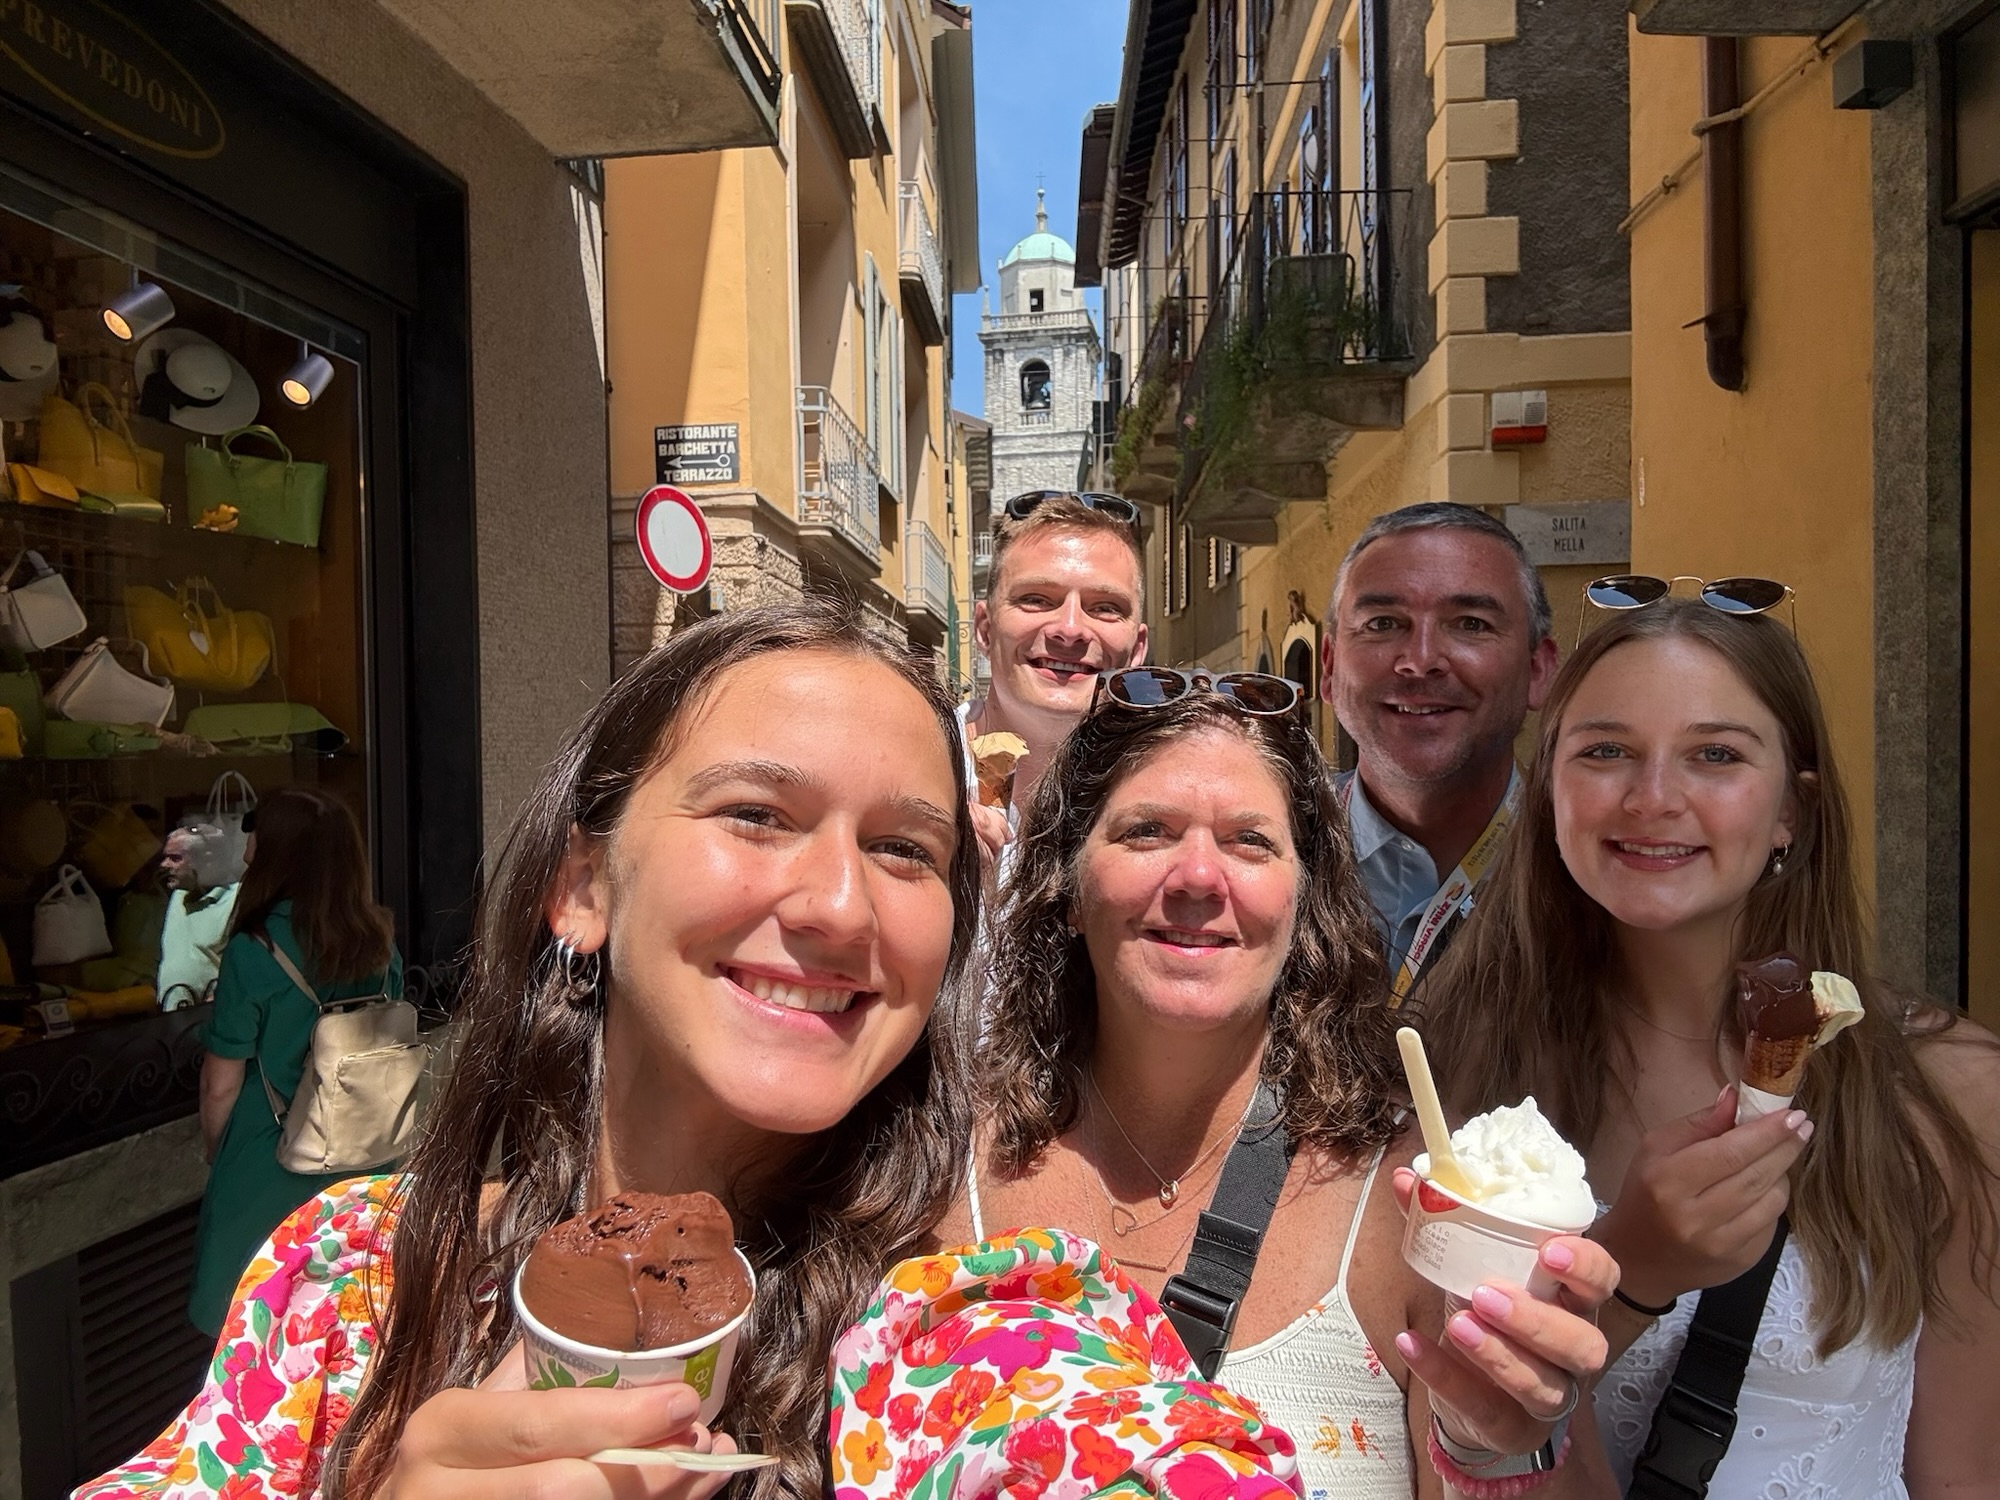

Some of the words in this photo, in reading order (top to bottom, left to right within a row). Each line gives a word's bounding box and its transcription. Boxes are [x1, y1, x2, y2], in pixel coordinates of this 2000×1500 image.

[657, 425, 737, 440] RISTORANTE
[658, 441, 736, 456] BARCHETTA
[664, 468, 732, 482] TERRAZZO
[1552, 517, 1586, 532] SALITA
[1554, 538, 1585, 552] MELLA
[1413, 928, 1434, 960] VIAGG
